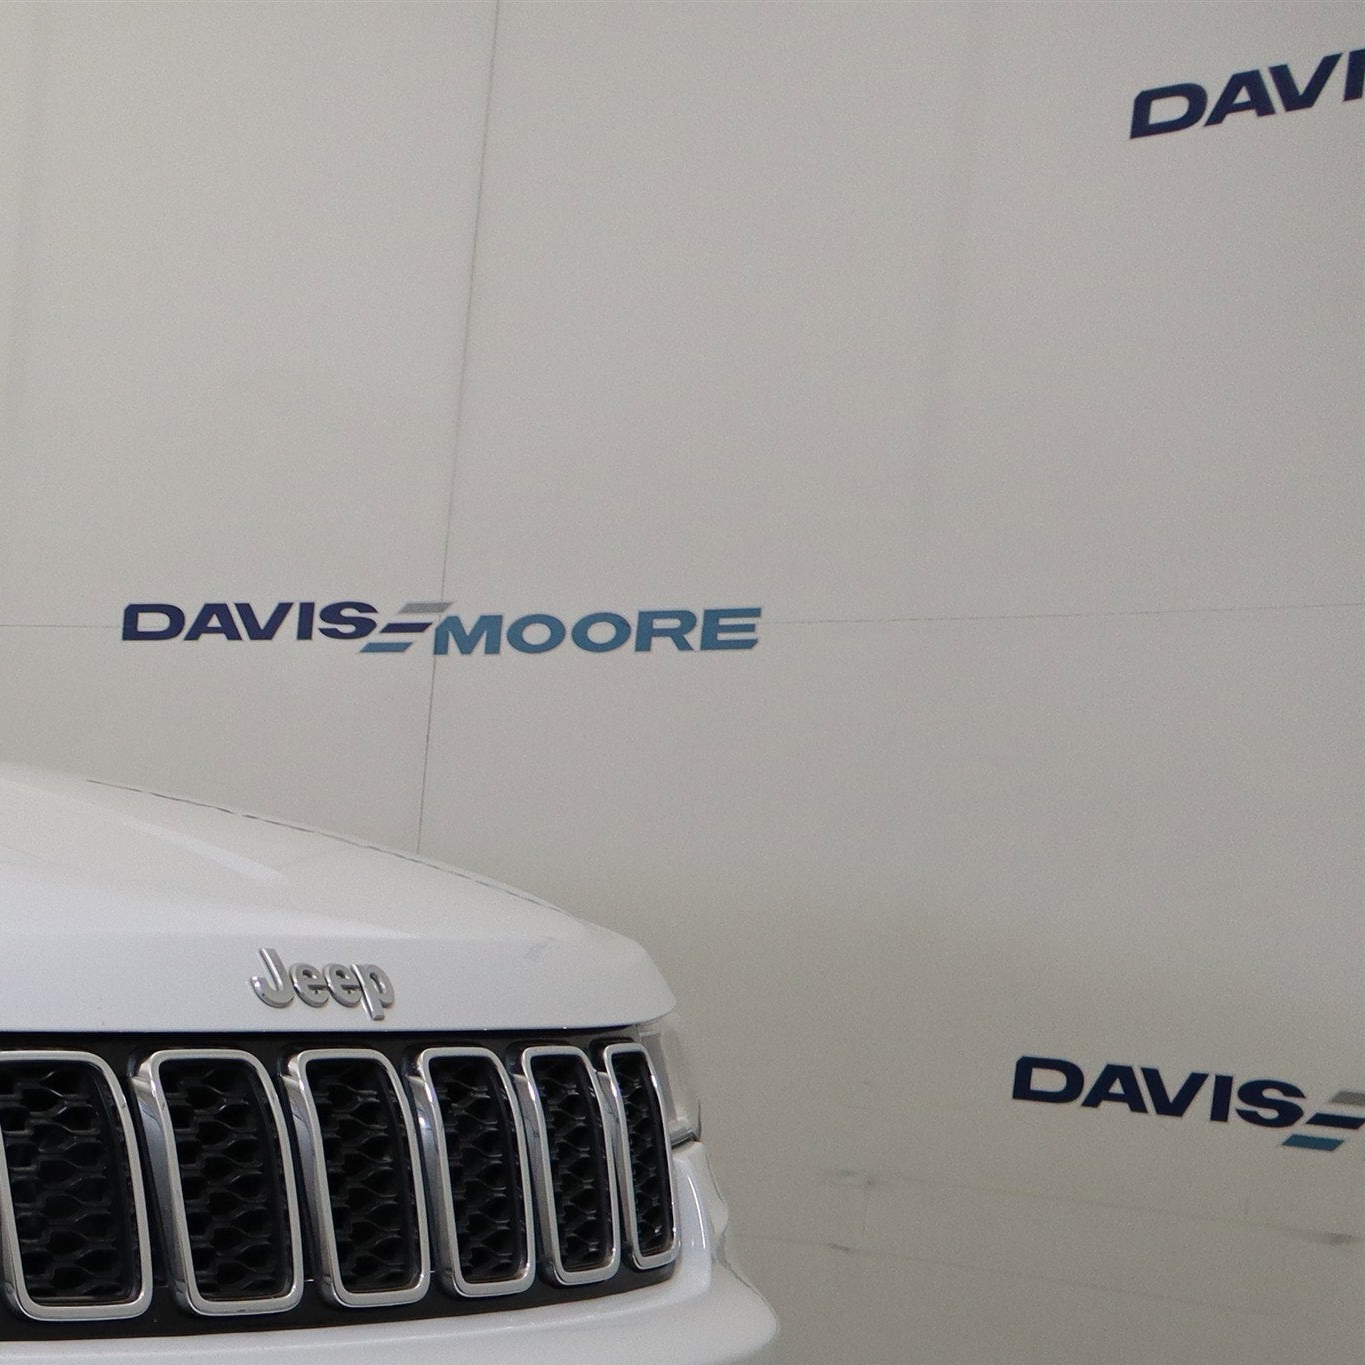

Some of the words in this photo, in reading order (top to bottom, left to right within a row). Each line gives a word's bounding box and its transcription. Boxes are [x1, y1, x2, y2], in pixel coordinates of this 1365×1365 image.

[120, 600, 380, 643] DAVIS
[432, 606, 763, 656] MOORE
[249, 947, 396, 1021] Jeep
[1012, 1055, 1307, 1129] DAVIS
